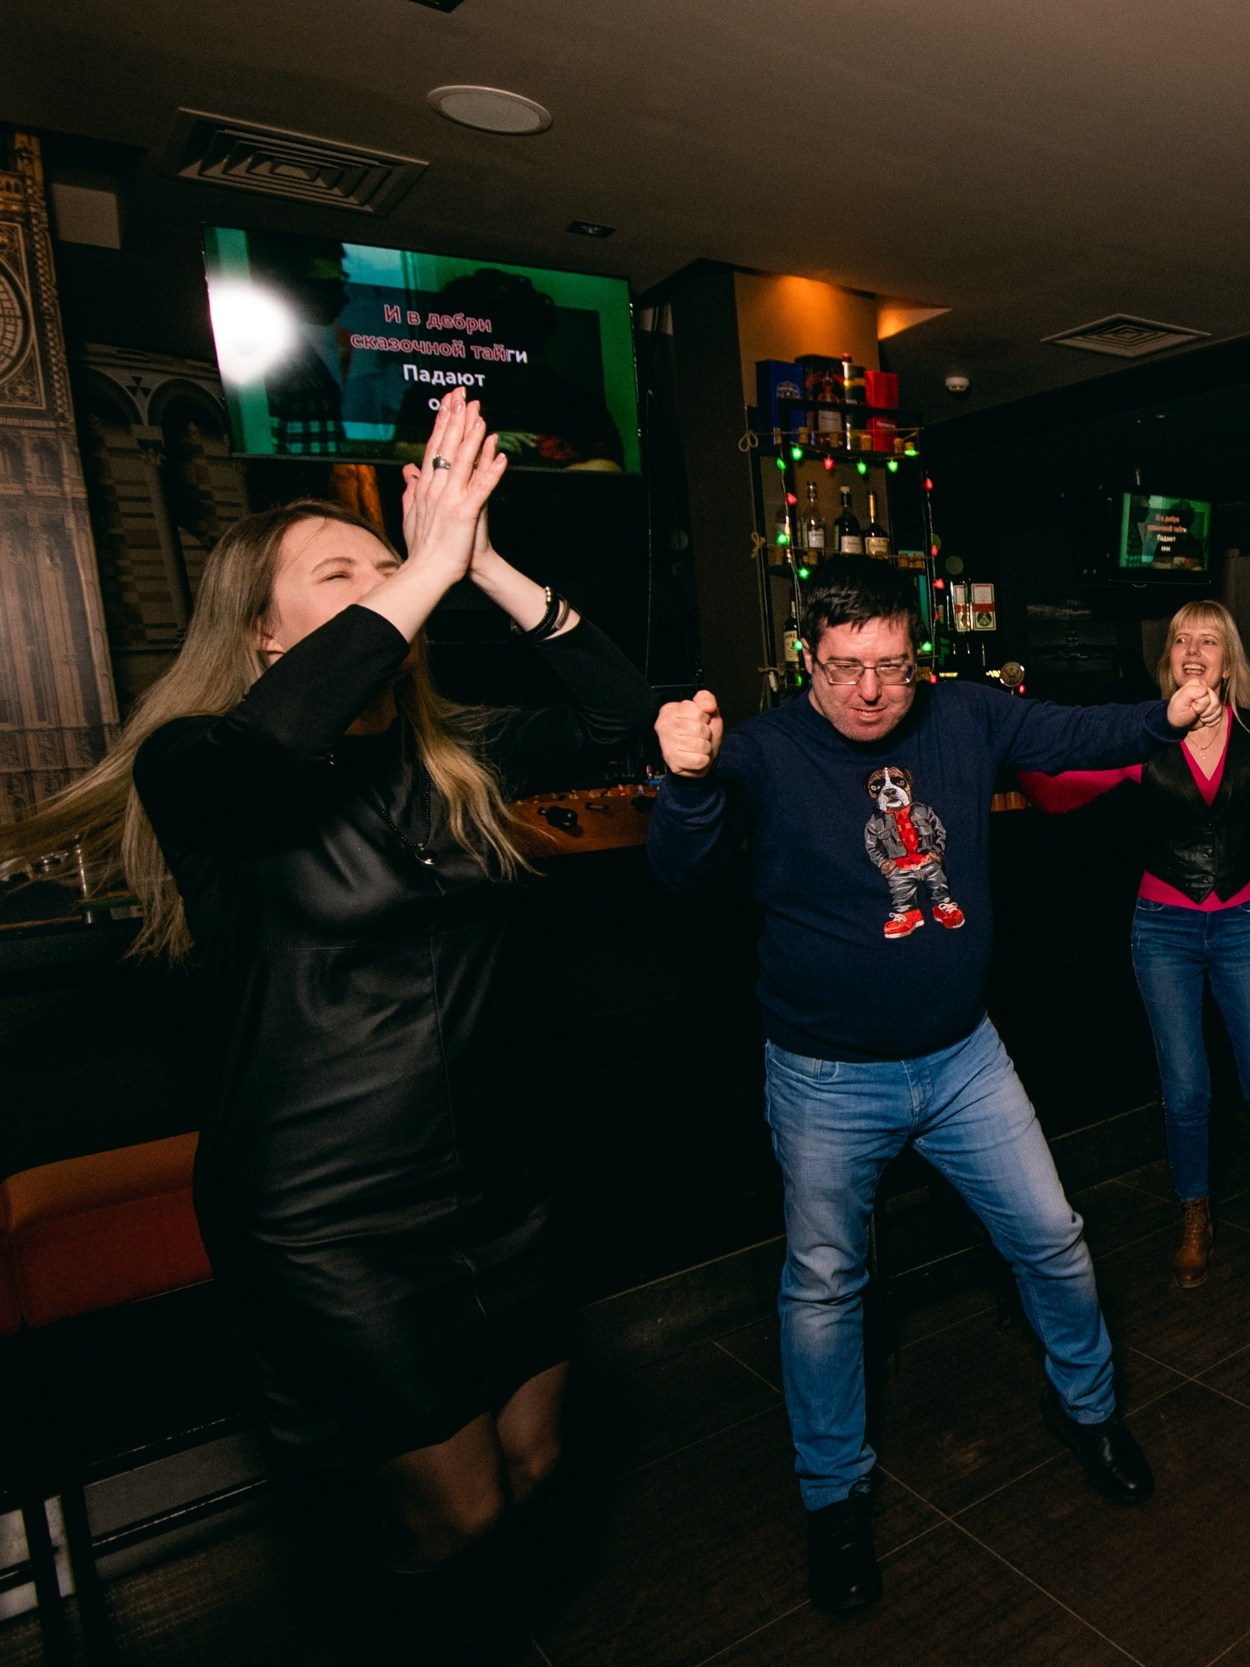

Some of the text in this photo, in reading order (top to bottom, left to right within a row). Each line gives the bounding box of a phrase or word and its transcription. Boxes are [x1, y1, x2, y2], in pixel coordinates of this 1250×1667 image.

[384, 304, 492, 335] И в дебри
[350, 333, 528, 364] сказочной тайги
[403, 364, 486, 387] Падают
